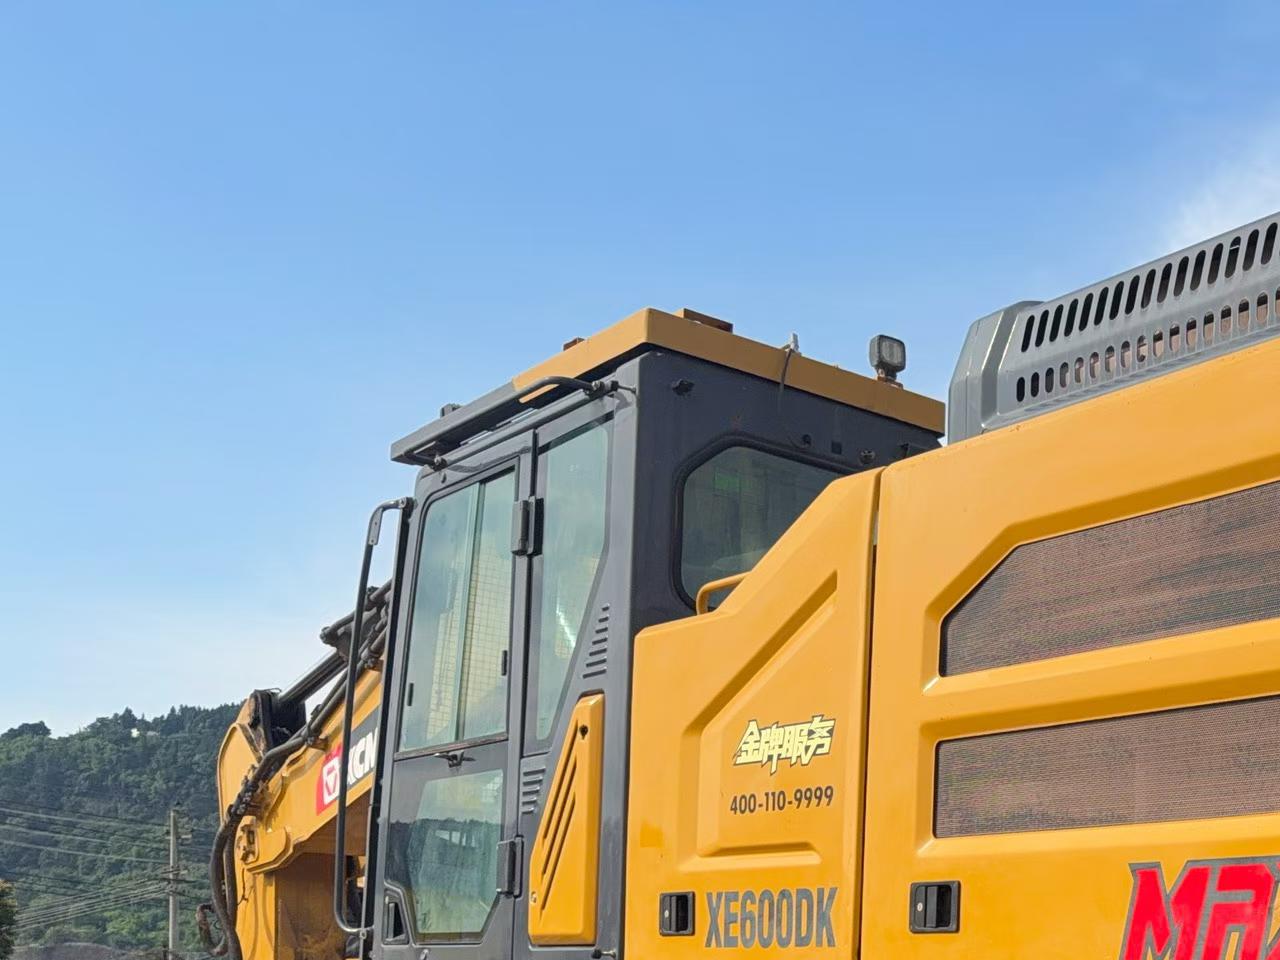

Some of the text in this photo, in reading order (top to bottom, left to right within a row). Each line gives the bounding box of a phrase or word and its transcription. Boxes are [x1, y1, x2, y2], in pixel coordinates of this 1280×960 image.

[733, 714, 836, 776] 金牌服务
[729, 785, 834, 815] 400-110-9999
[705, 887, 838, 949] XE600DK
